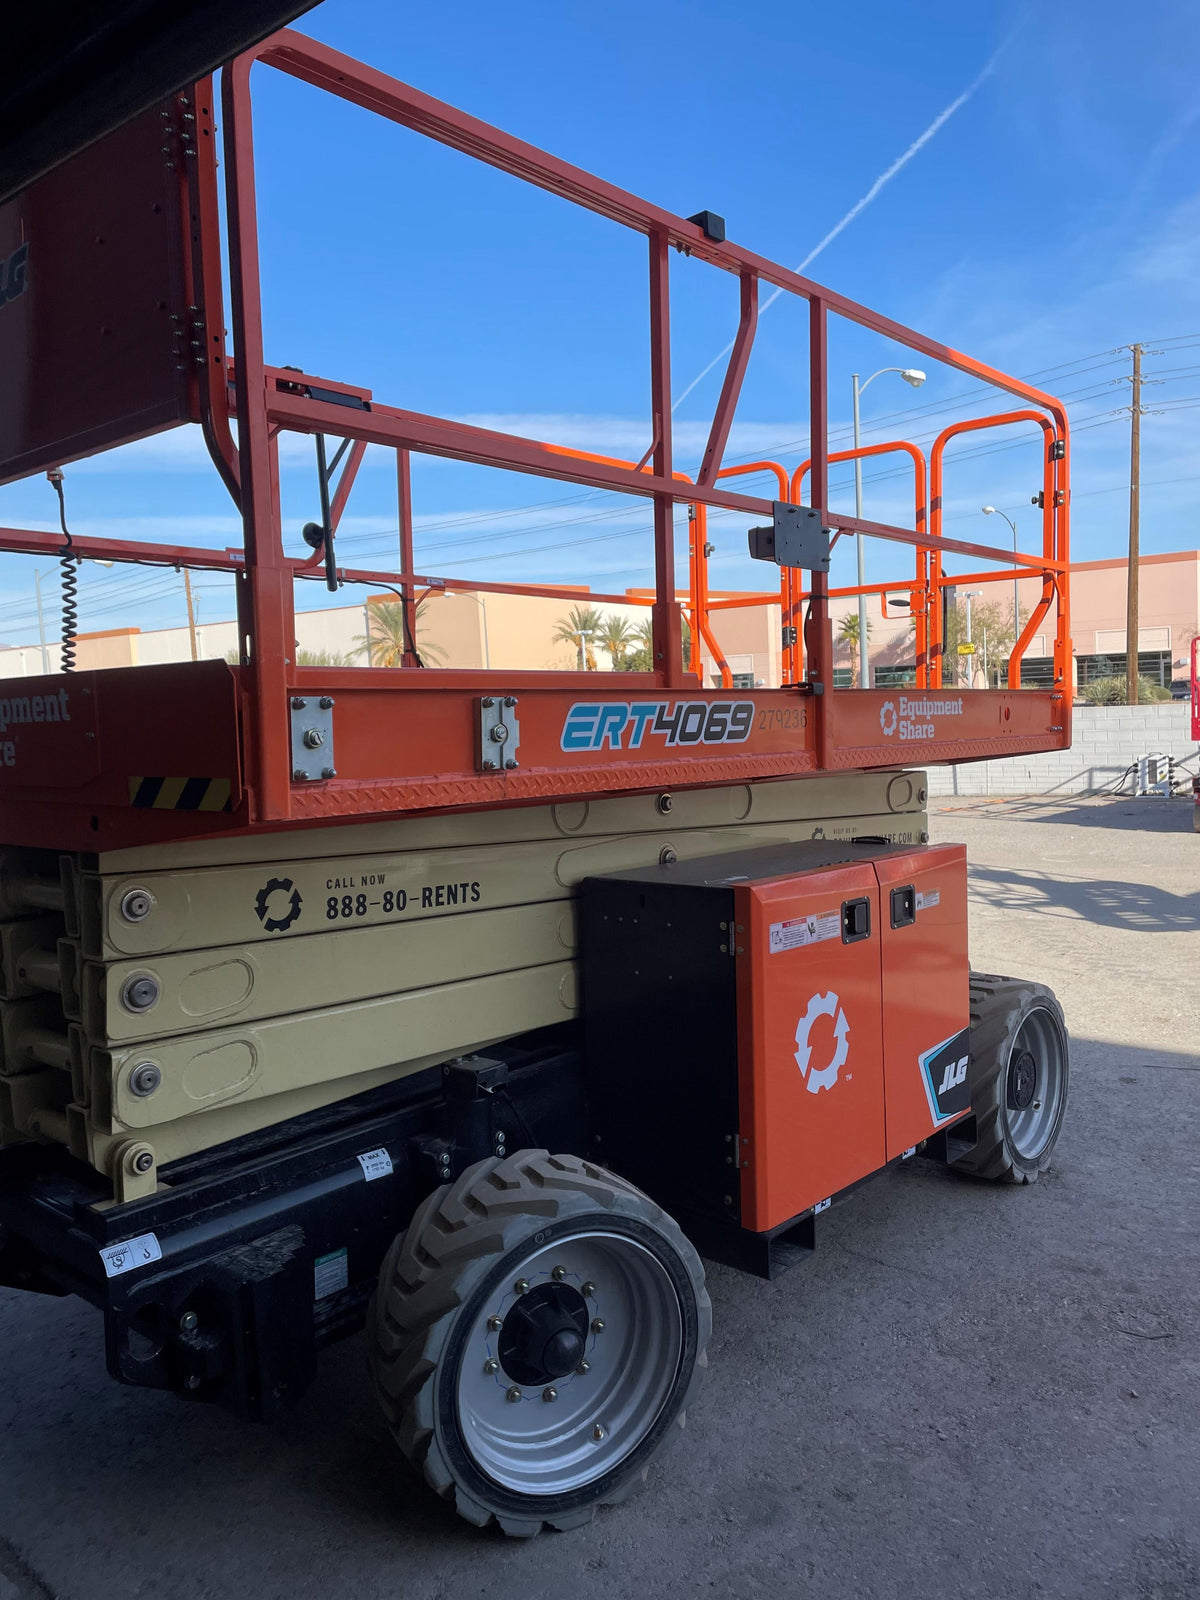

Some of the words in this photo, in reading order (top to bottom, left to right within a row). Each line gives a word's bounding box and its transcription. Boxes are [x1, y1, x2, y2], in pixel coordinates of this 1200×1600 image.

[758, 709, 808, 730] 279236
[899, 697, 963, 720] Equipment
[561, 701, 754, 751] ERT4069
[899, 721, 934, 740] Share
[326, 877, 355, 890] CALL
[361, 874, 386, 886] NOW
[326, 881, 481, 920] 888-80-RENTS
[938, 1055, 969, 1095] JLG
